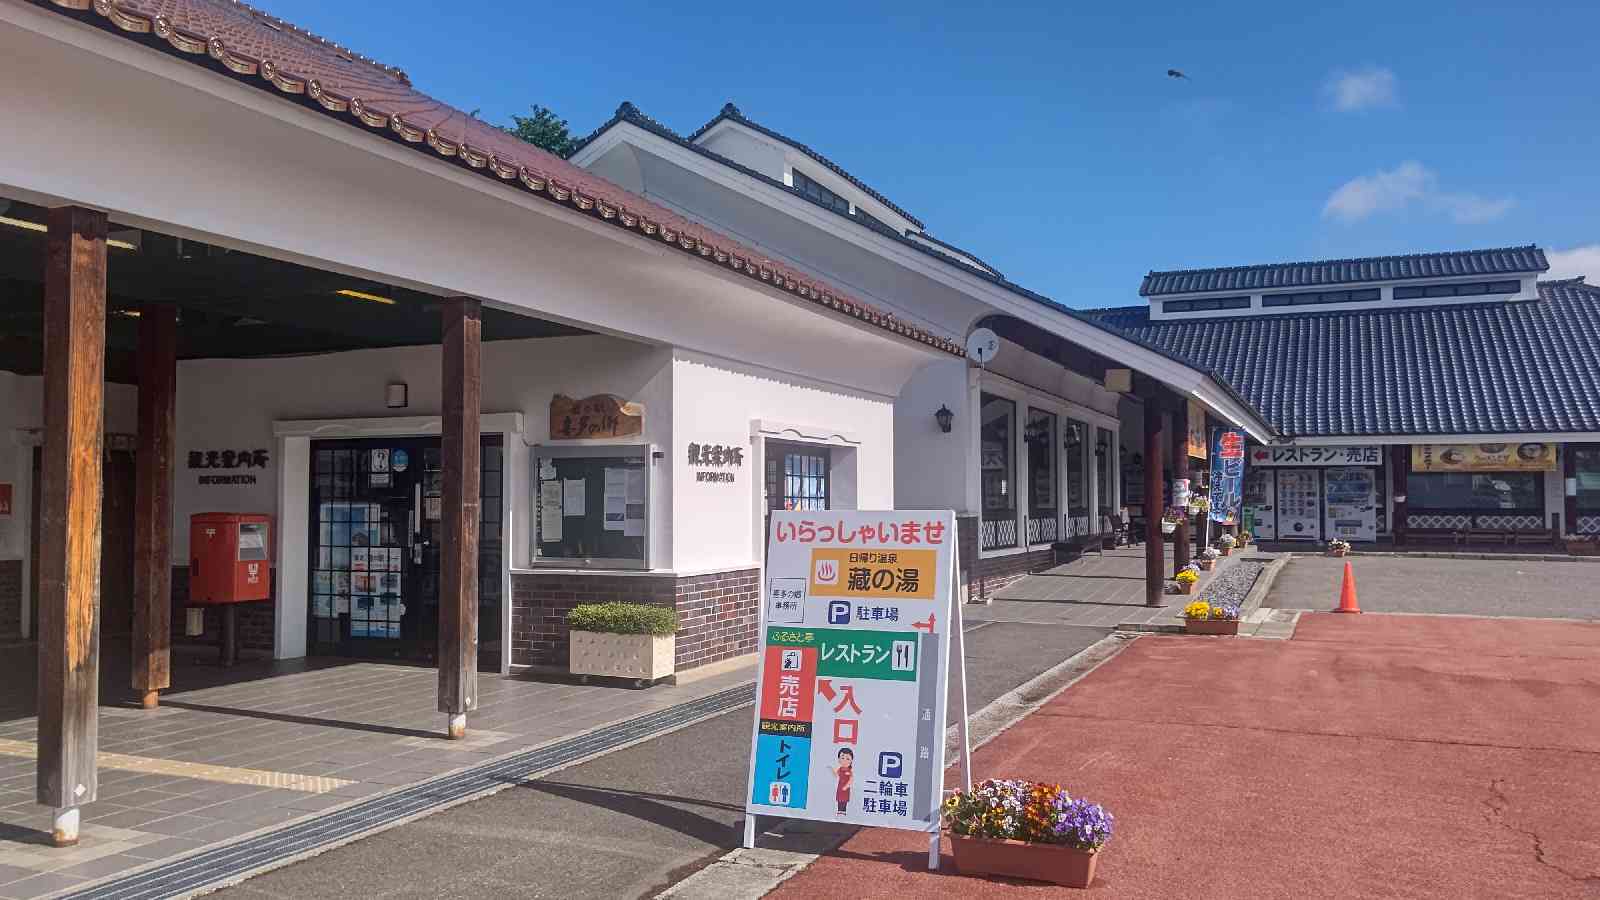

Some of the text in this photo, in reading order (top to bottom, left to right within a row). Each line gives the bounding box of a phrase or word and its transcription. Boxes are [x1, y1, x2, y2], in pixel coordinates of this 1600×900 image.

[1272, 447, 1379, 463] レストラン・売店
[198, 474, 257, 485] INFORMATION
[695, 471, 735, 483] INFORMATION
[776, 520, 945, 545] いらっしゃいませ
[849, 552, 898, 564] 日帰り温泉
[775, 600, 797, 612] 事務所
[830, 604, 899, 622] P 駐車場
[820, 642, 891, 665] レストラン
[777, 675, 800, 718] 売店
[832, 685, 863, 745] 入口
[761, 721, 806, 733] 観光案内所
[775, 739, 792, 780] トイレ
[881, 755, 902, 775] P
[863, 780, 909, 797] 二輪車
[863, 797, 908, 817] 駐車場
